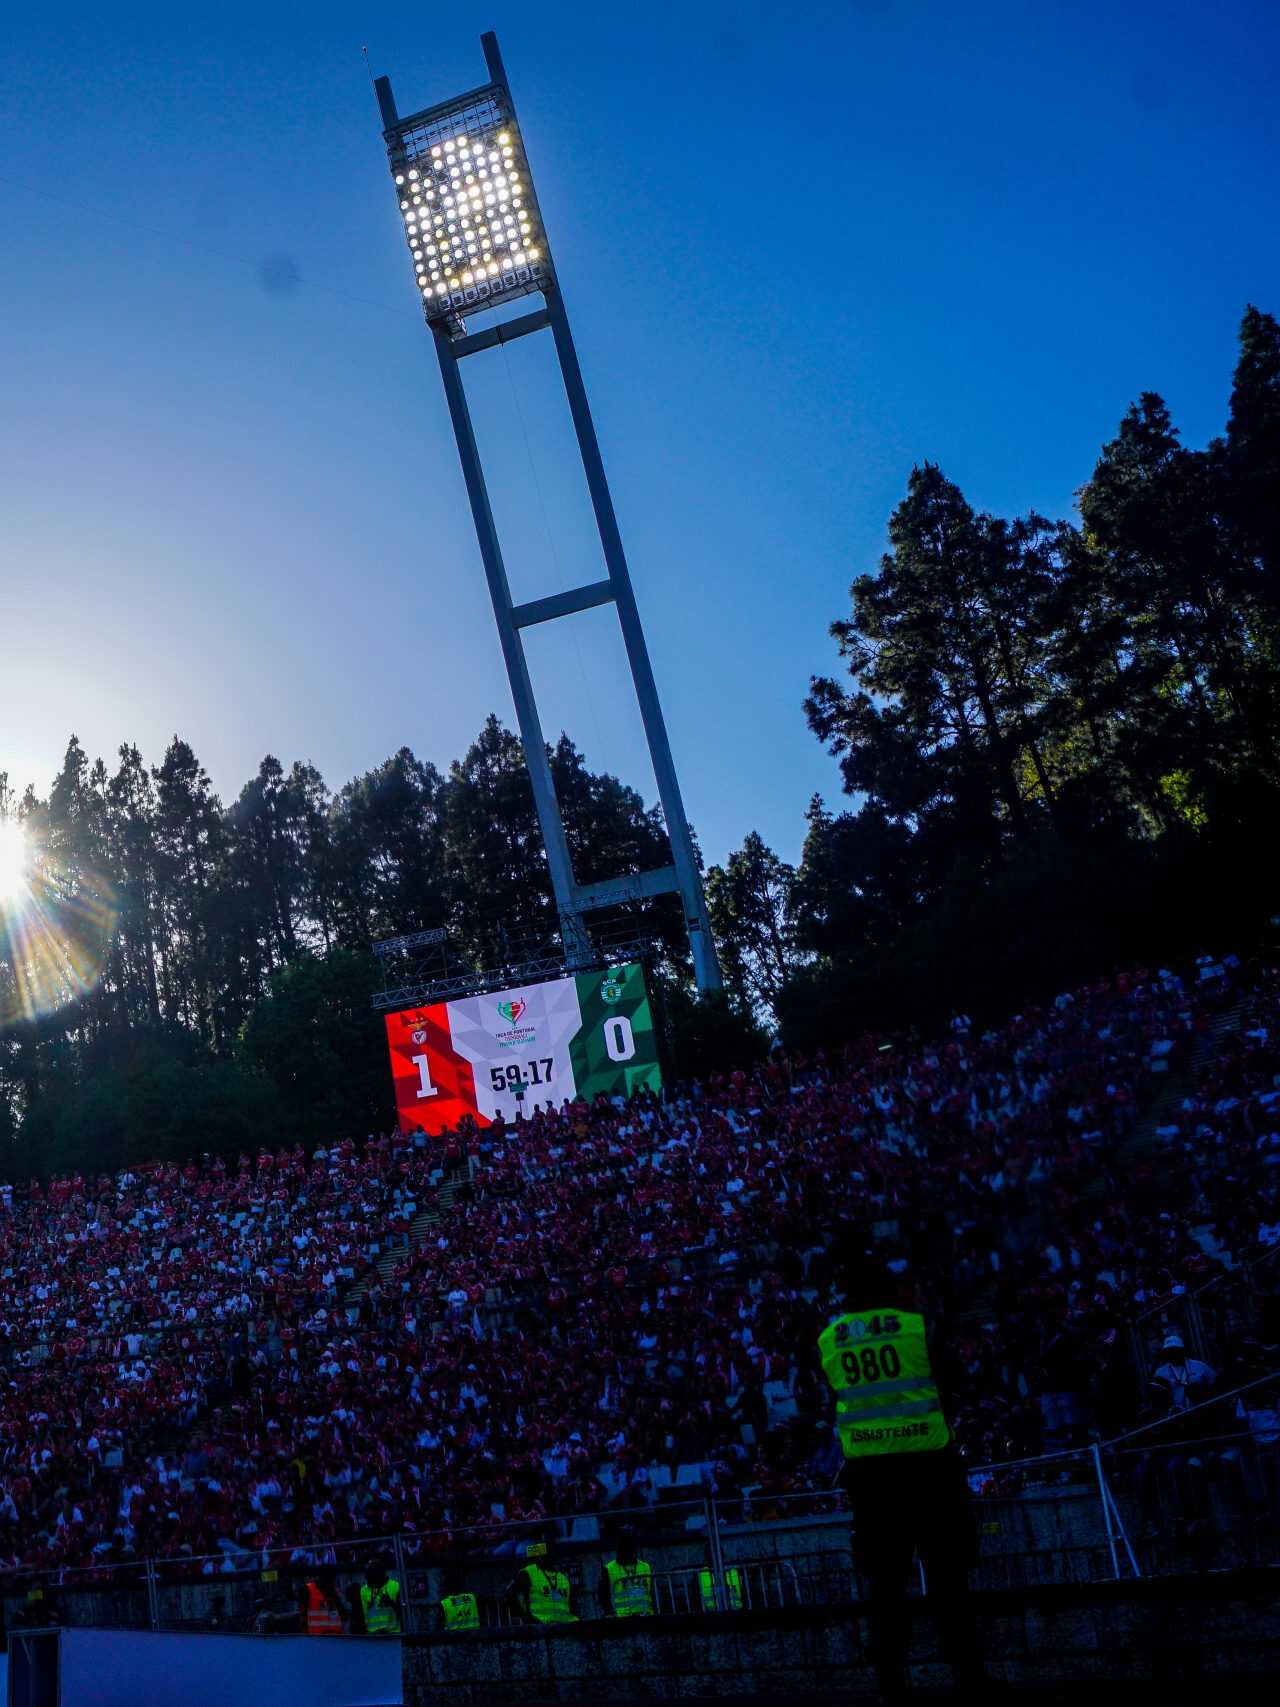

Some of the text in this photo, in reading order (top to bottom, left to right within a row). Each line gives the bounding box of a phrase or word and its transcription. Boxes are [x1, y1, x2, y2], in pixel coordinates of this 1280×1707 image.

[603, 1015, 636, 1063] 0
[411, 1053, 438, 1099] 1
[840, 1344, 900, 1385] 980
[851, 1422, 928, 1443] ASSISTENTE
